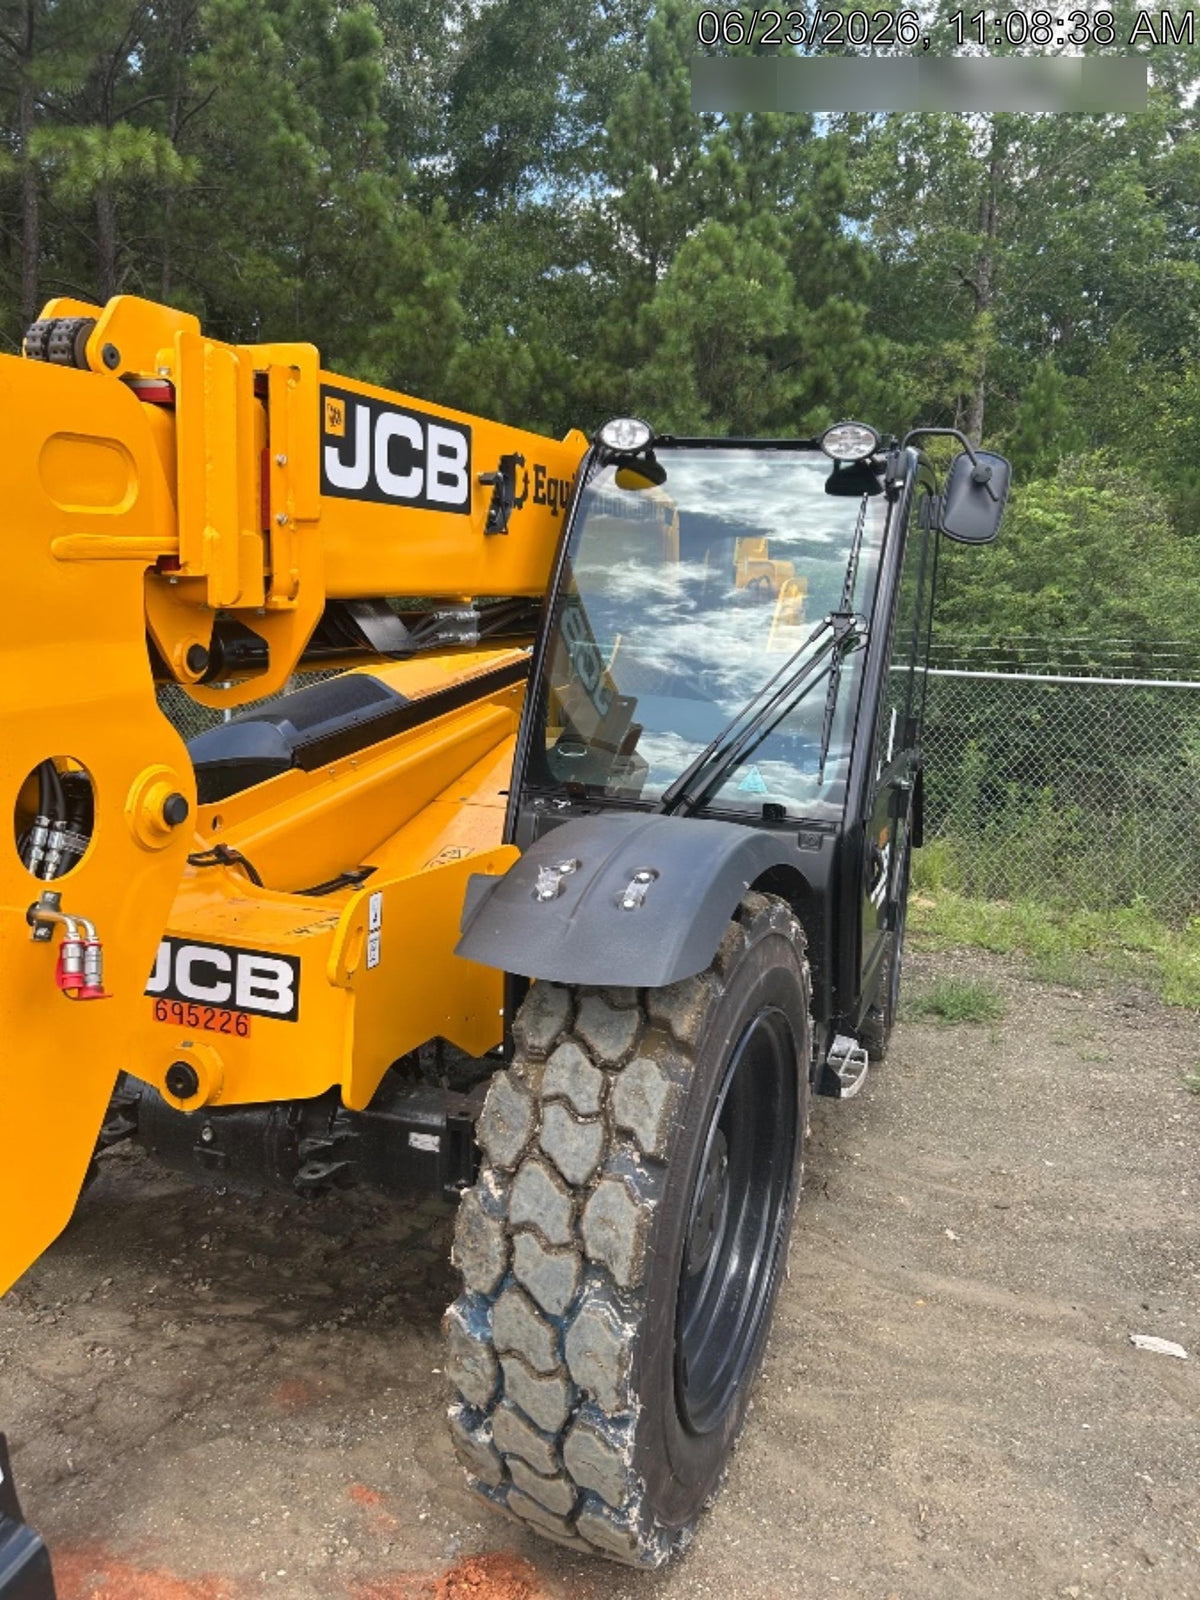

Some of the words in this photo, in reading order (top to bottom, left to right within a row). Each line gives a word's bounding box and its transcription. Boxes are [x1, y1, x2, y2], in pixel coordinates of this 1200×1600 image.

[324, 404, 469, 505] JCB
[532, 463, 577, 517] Equ
[145, 942, 295, 1015] JCB
[155, 999, 249, 1037] 695226
